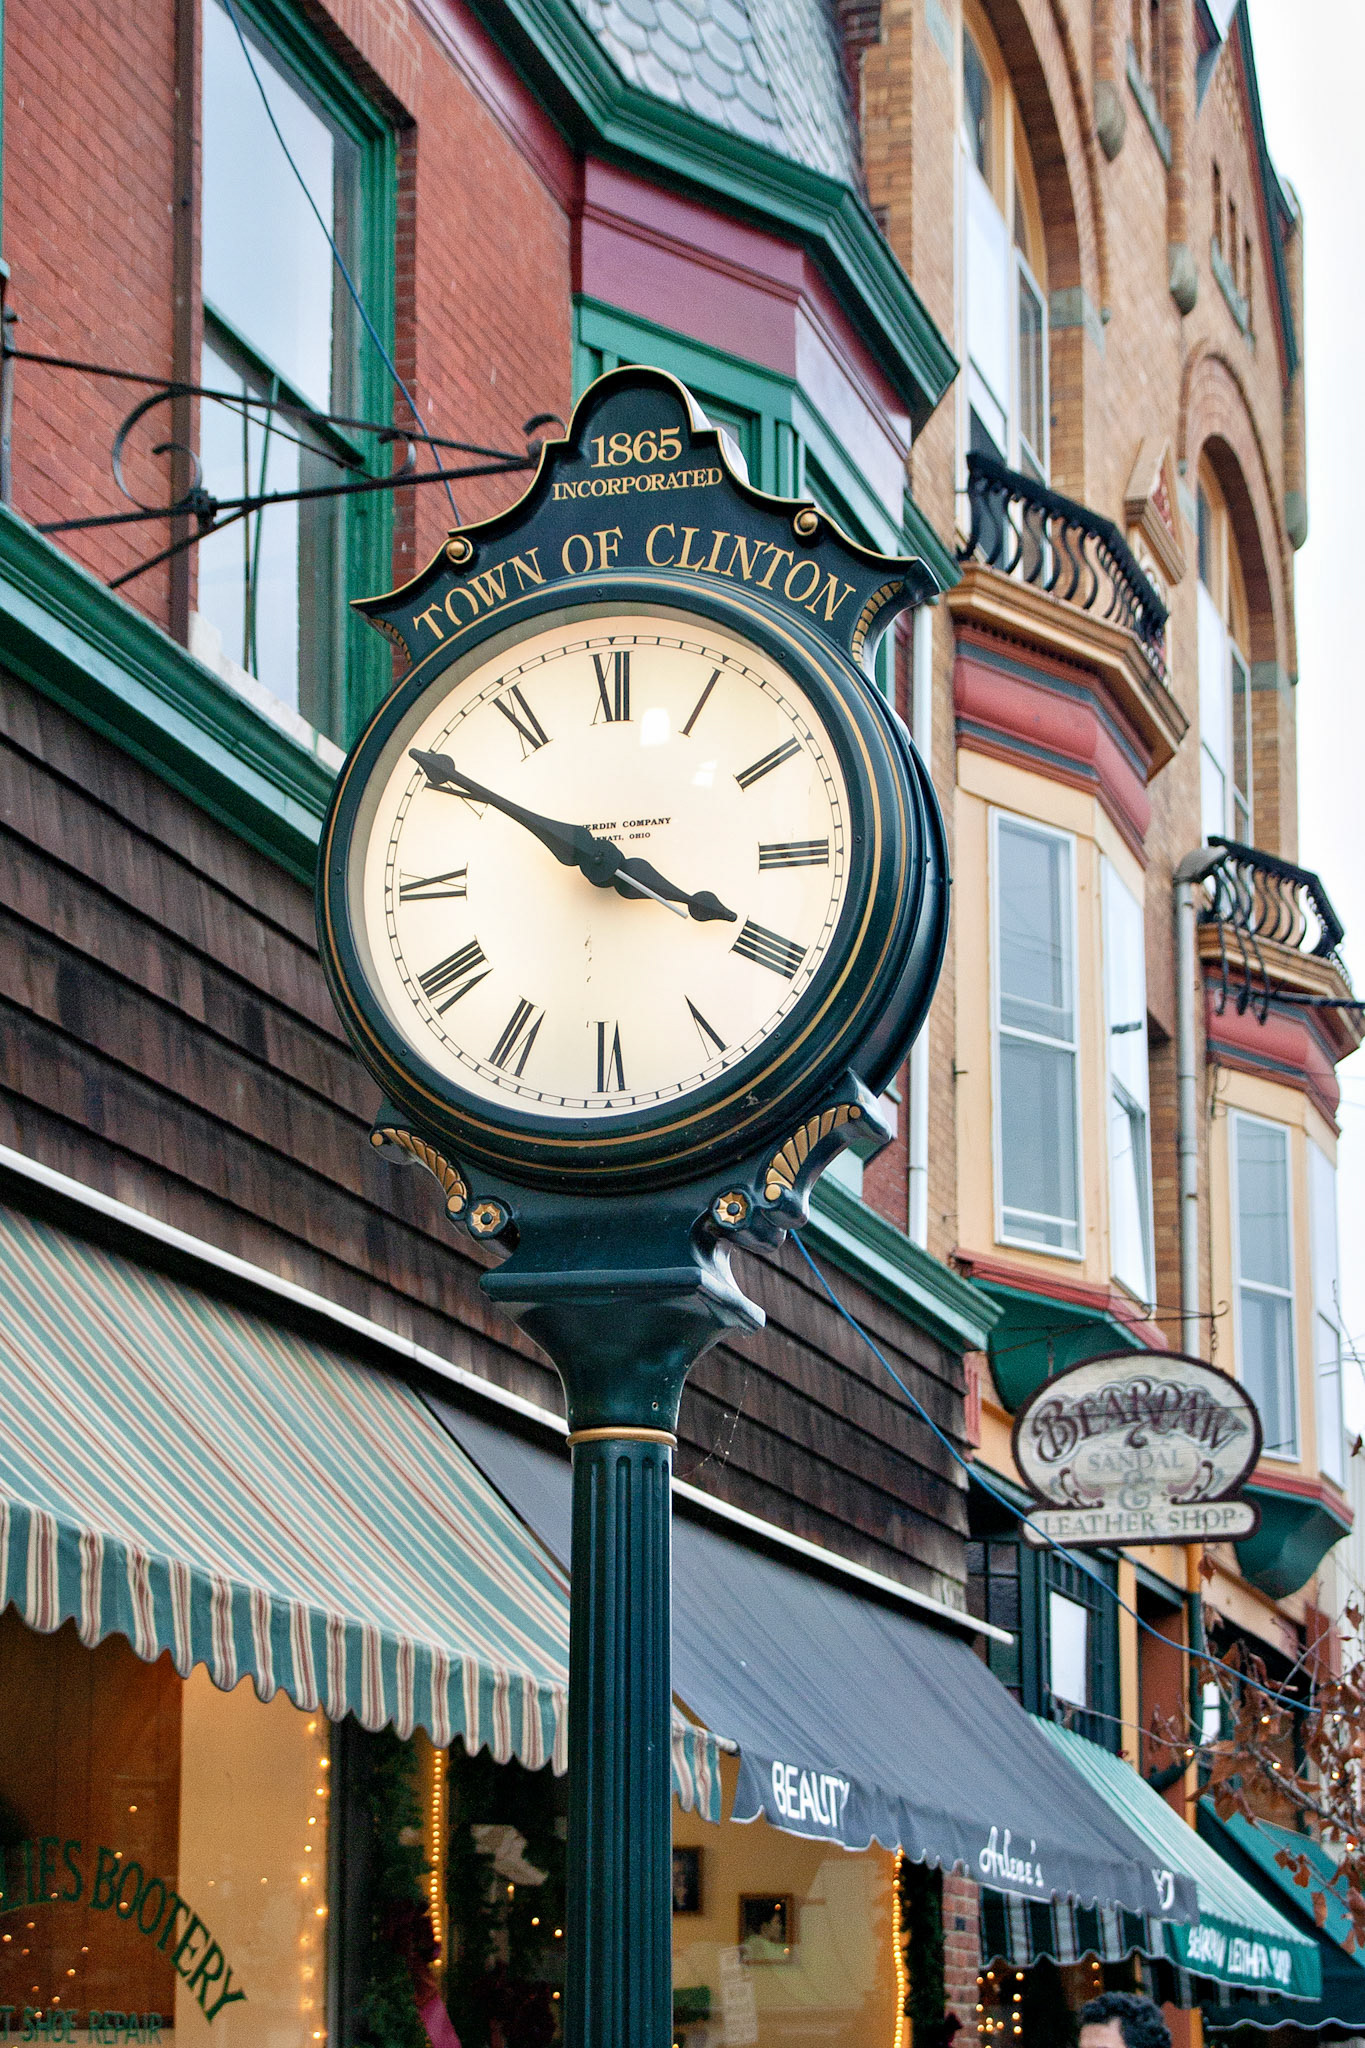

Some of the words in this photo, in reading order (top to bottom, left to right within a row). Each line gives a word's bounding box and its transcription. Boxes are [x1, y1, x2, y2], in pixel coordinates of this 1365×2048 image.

[590, 426, 683, 468] 1865
[552, 467, 723, 501] INCORPORATED
[413, 546, 548, 641] TOWN
[561, 525, 624, 574] OF
[646, 523, 857, 622] CLINTON
[588, 650, 634, 726] XII
[488, 682, 554, 762] XI
[733, 733, 805, 792] II
[582, 821, 617, 831] ERDIN
[622, 817, 671, 828] COMPANY
[629, 832, 651, 840] OHIO
[758, 836, 829, 874] III
[1087, 1449, 1185, 1474] SANDAL
[1043, 1510, 1158, 1537] LEATHER
[1167, 1506, 1237, 1531] SHOP
[772, 1760, 850, 1830] BEAUTY
[89, 1844, 248, 2026] BOOTERY
[21, 2006, 79, 2044] SHOE
[88, 2009, 164, 2045] REPAIR
